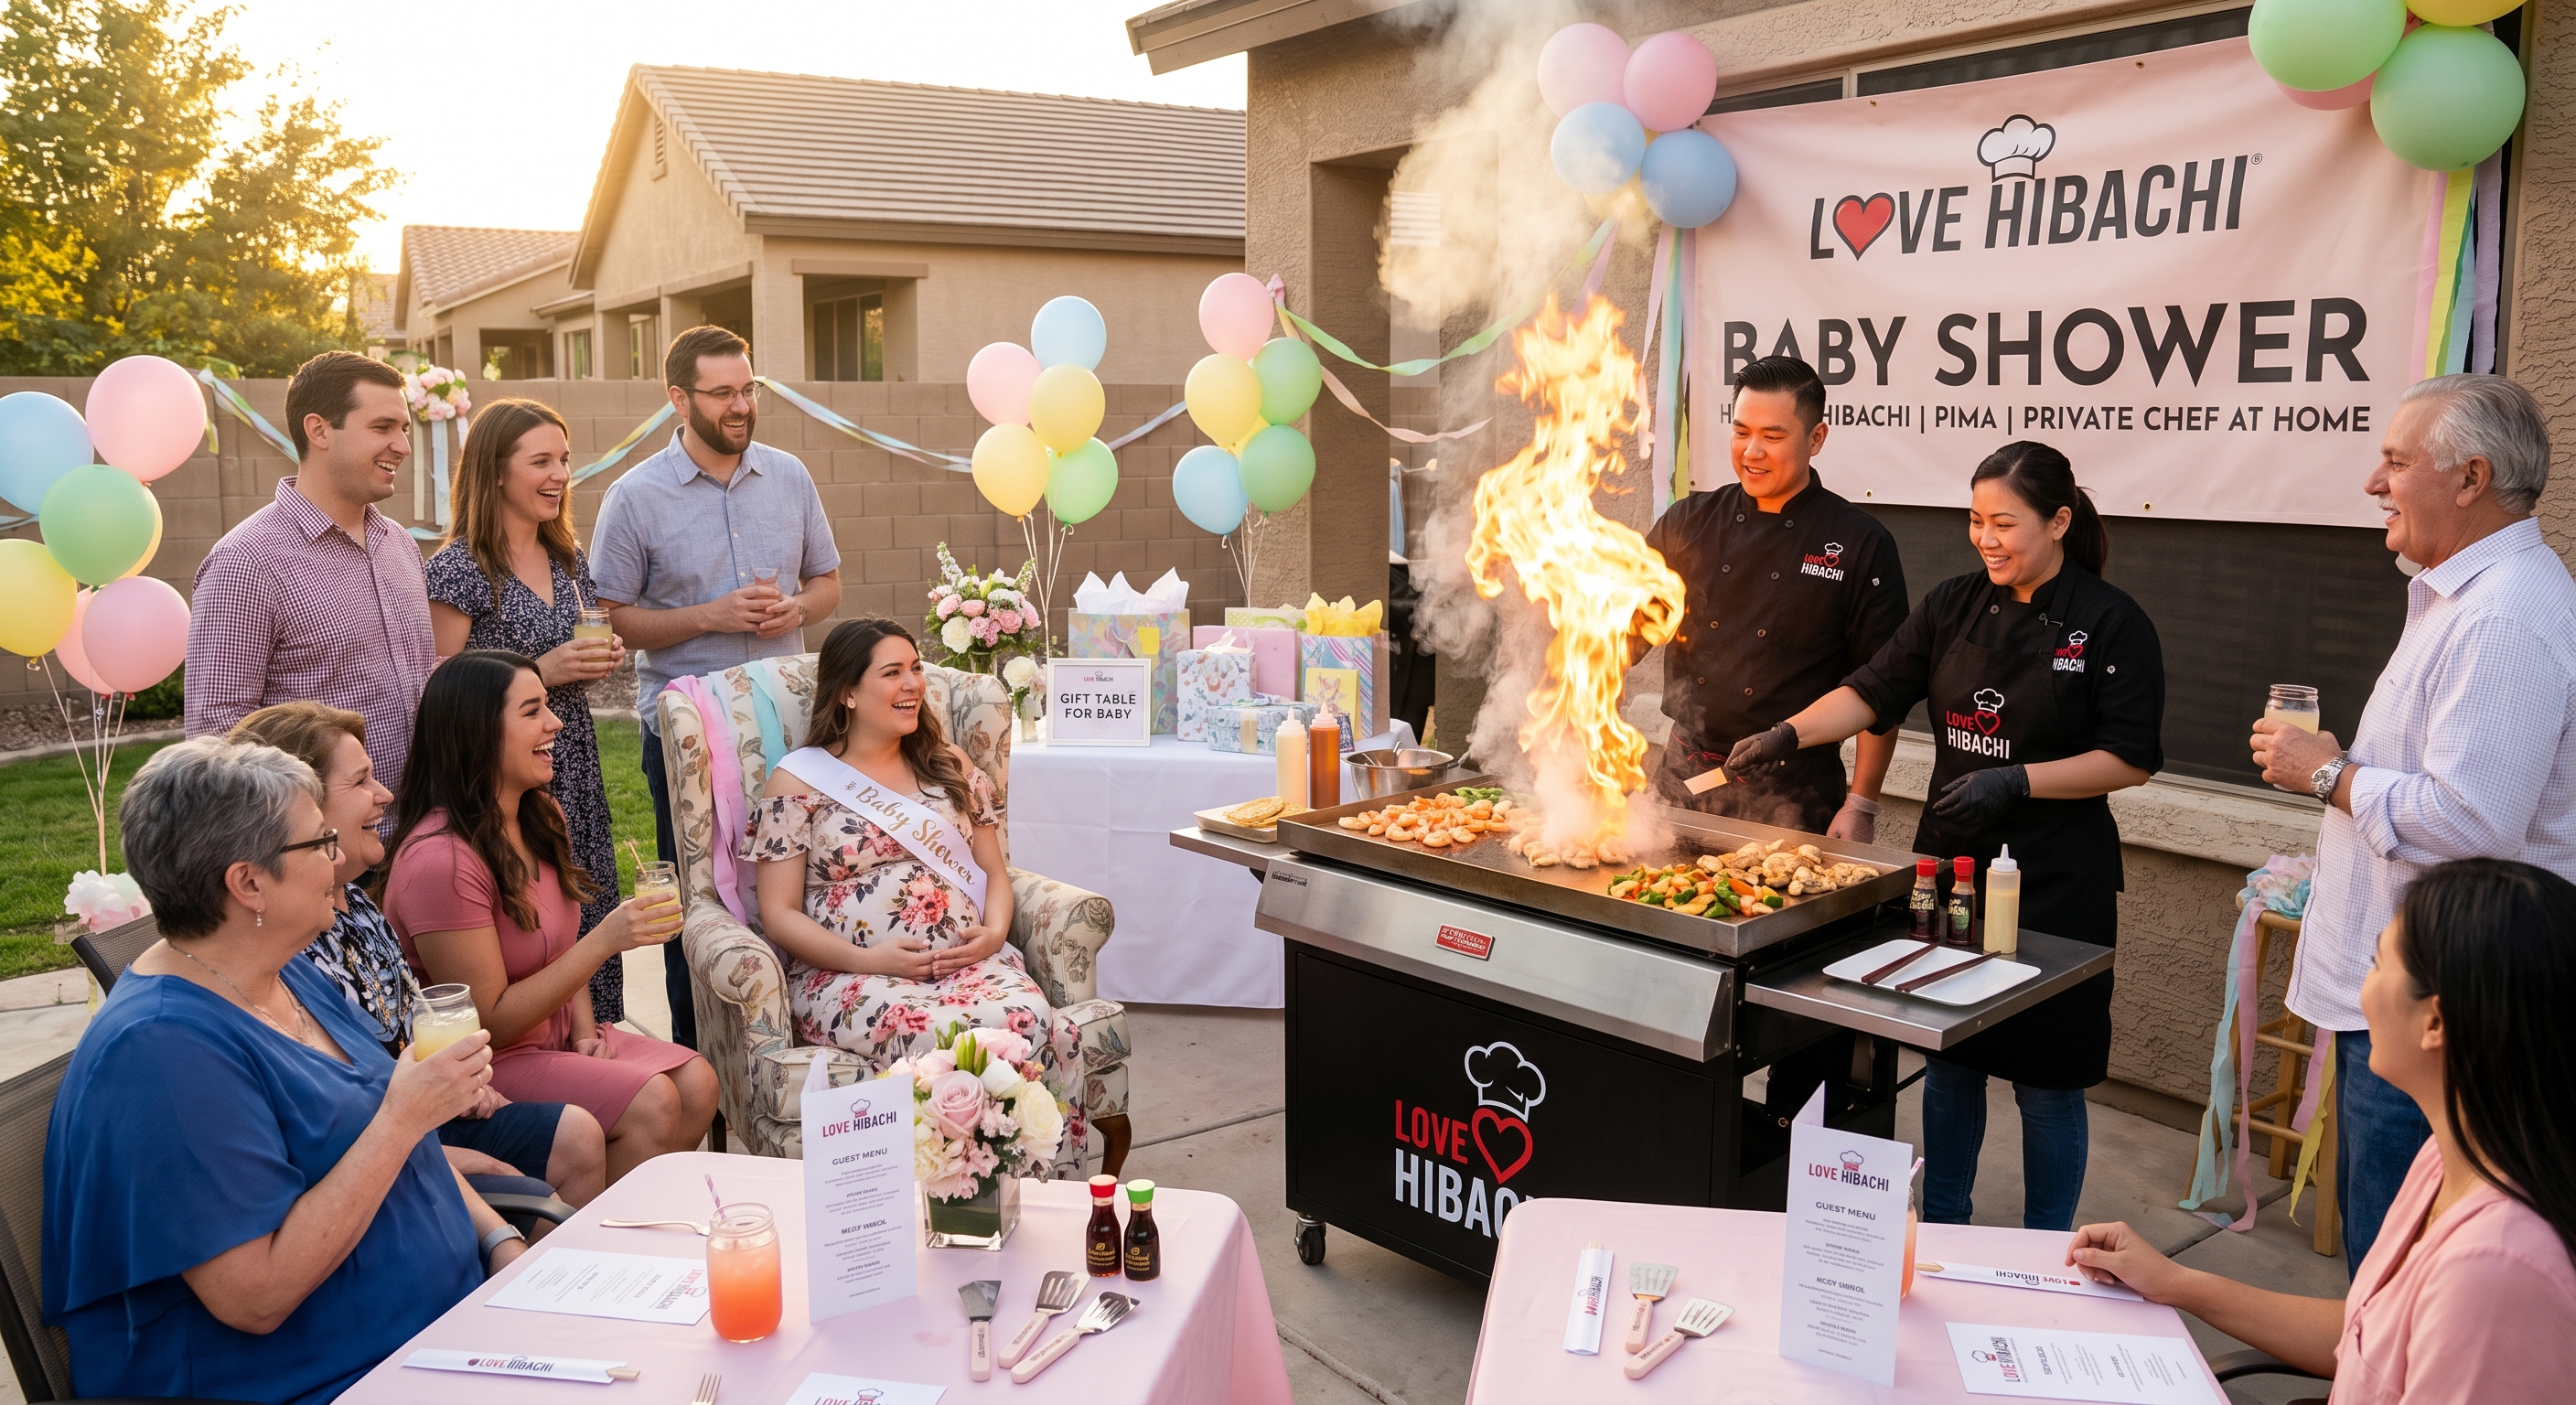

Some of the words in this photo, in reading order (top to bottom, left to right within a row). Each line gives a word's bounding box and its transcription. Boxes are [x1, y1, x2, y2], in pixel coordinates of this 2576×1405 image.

[1724, 316, 1907, 386] BABY
[1935, 297, 2370, 389] SHOWER
[1935, 407, 1997, 430] PIMA
[2023, 407, 2133, 431] PRIVATE
[2143, 407, 2218, 432] CHEF
[2227, 407, 2264, 432] AT
[2273, 407, 2371, 433] HOME
[1800, 562, 1844, 582] HIBACHI
[1060, 693, 1090, 704] GIFT
[1095, 693, 1136, 704] TABLE
[1065, 708, 1092, 719] FOR
[1097, 708, 1132, 720] BABY
[1946, 710, 1974, 731] LOVE
[1947, 727, 2011, 760] HIBACHI
[855, 785, 912, 832] Baby
[822, 1121, 851, 1138] LOVE
[853, 1110, 897, 1132] HIBACHI
[1395, 1099, 1468, 1165] LOVE
[832, 1153, 861, 1165] GUEST
[862, 1147, 888, 1159] MENU
[1809, 1163, 1838, 1181] LOVE
[1841, 1170, 1889, 1192] HIBACHI
[1815, 1201, 1846, 1214] GUEST
[1847, 1207, 1876, 1221] MENU
